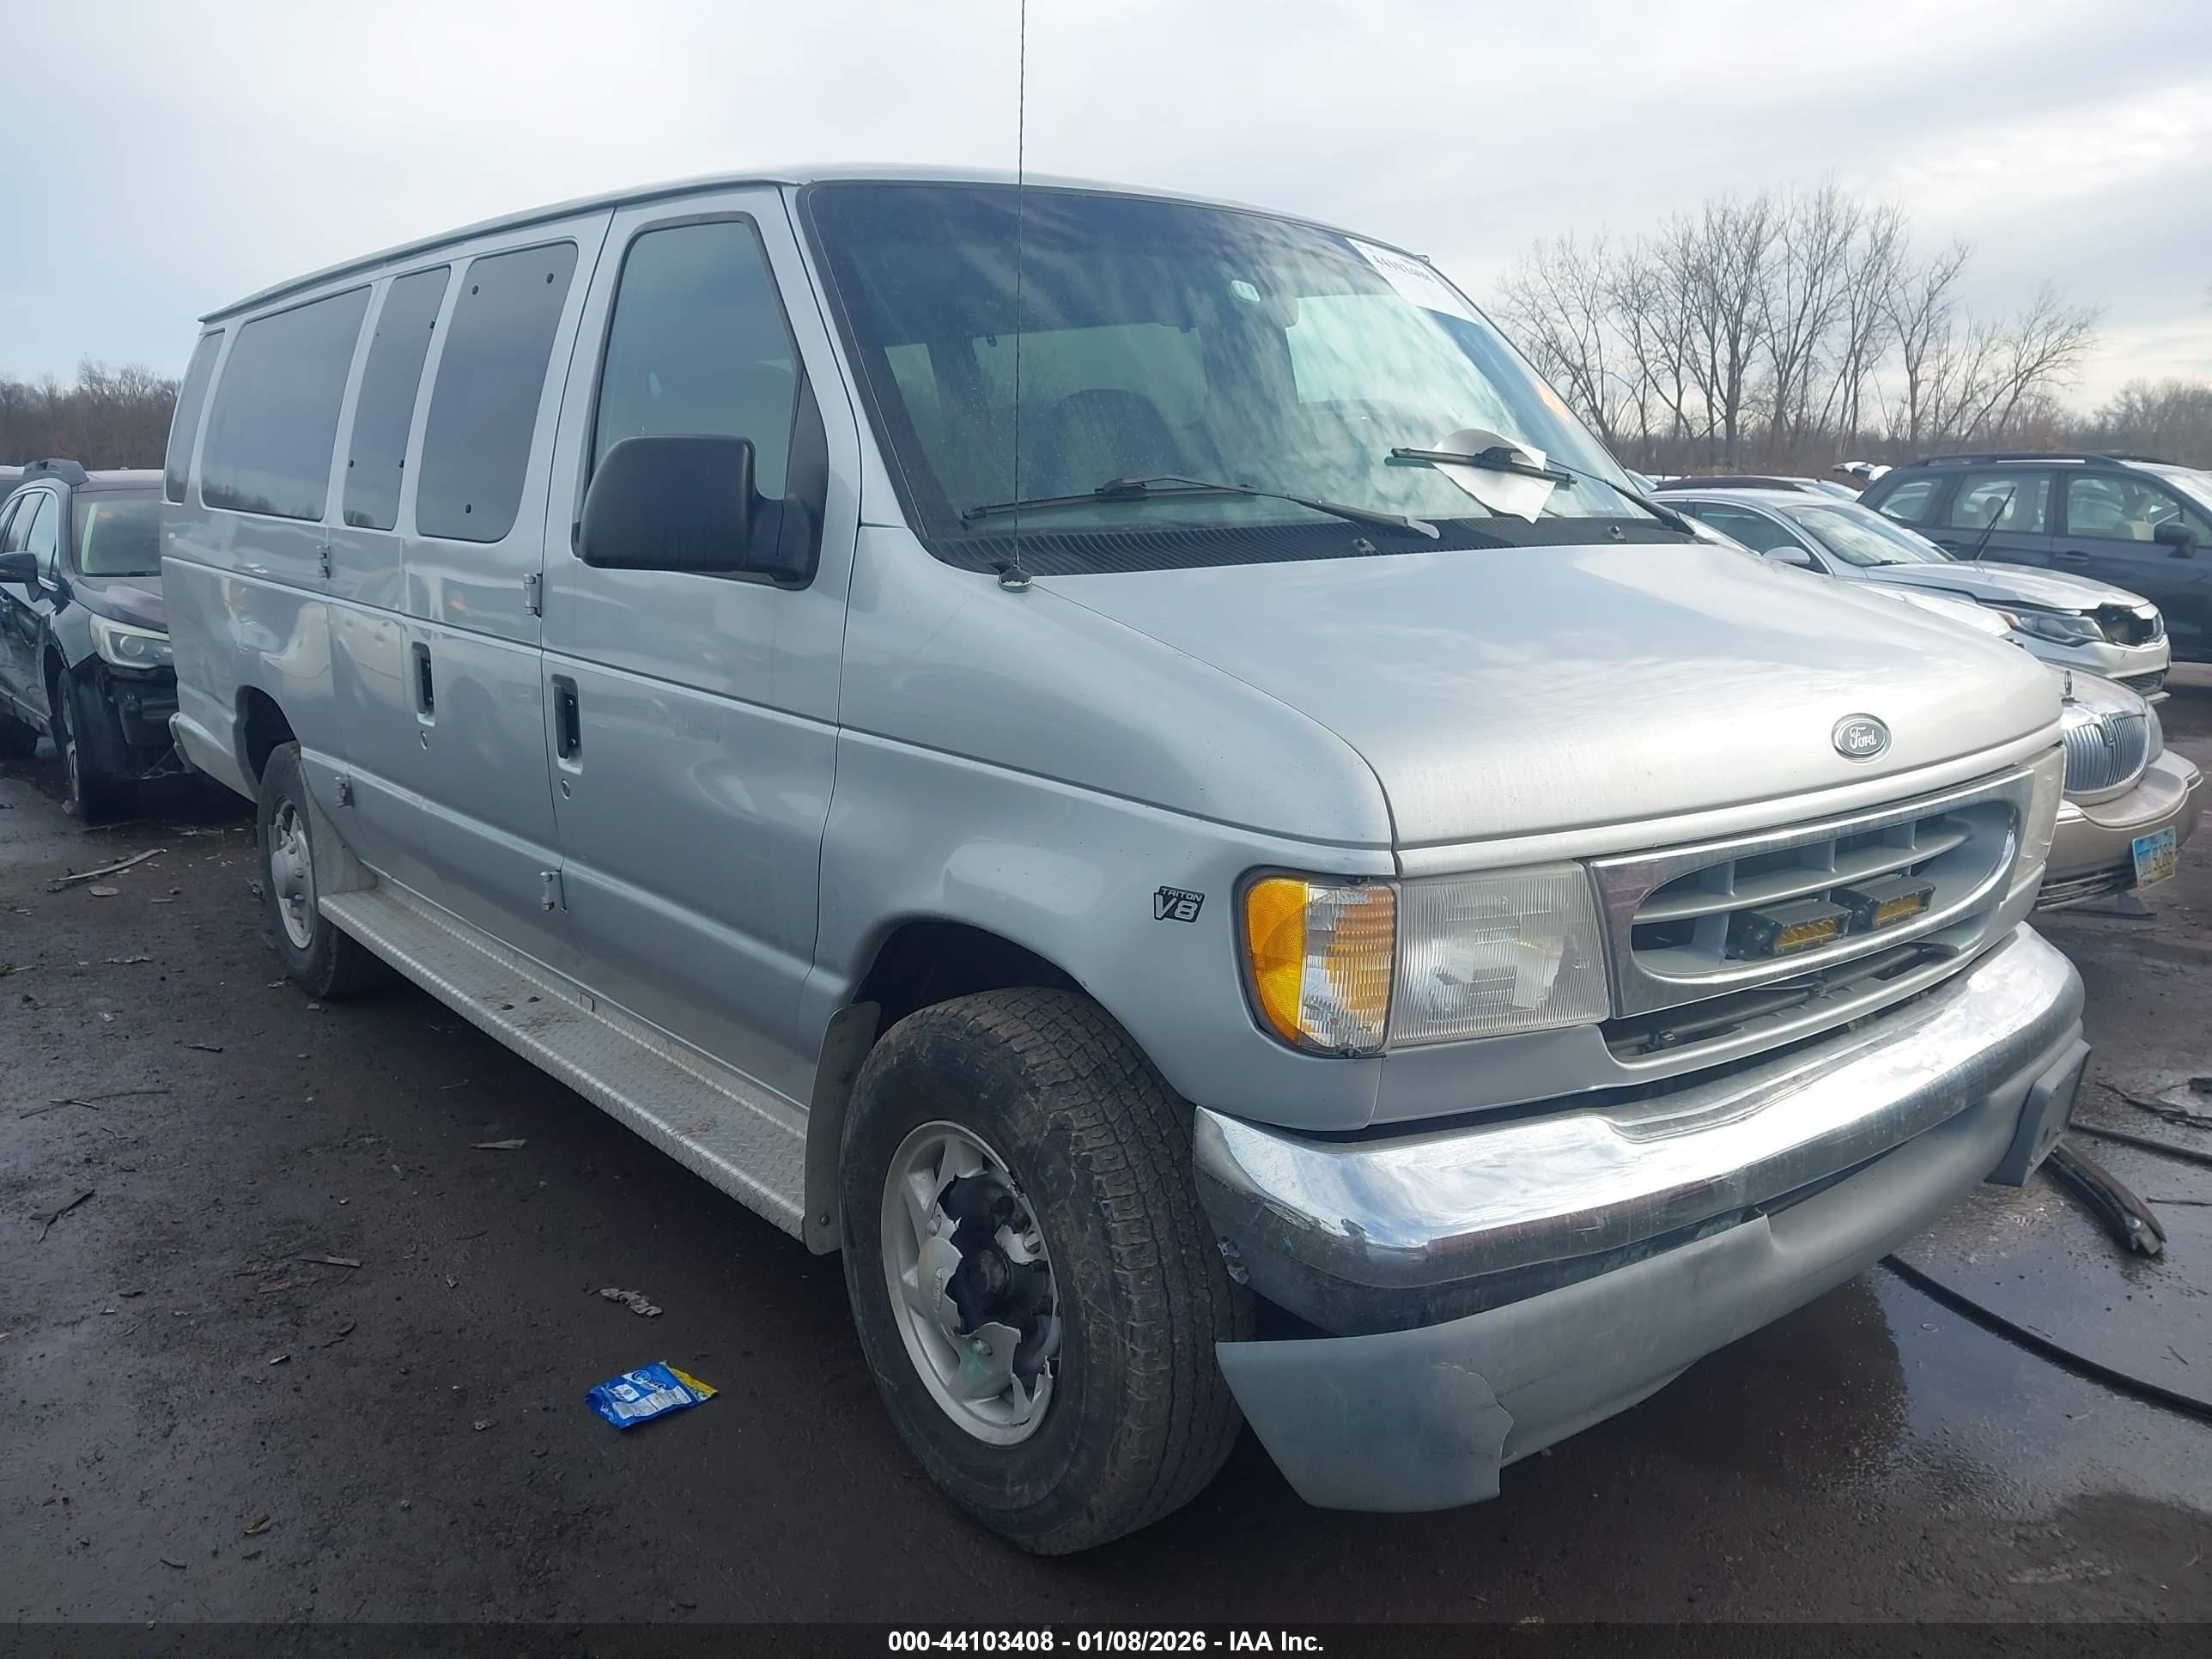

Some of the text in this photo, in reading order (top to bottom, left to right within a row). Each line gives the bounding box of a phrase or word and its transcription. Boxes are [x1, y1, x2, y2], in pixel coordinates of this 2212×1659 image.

[1849, 726, 1877, 750] Ford
[1155, 893, 1198, 921] V8
[1161, 888, 1203, 902] TRITON
